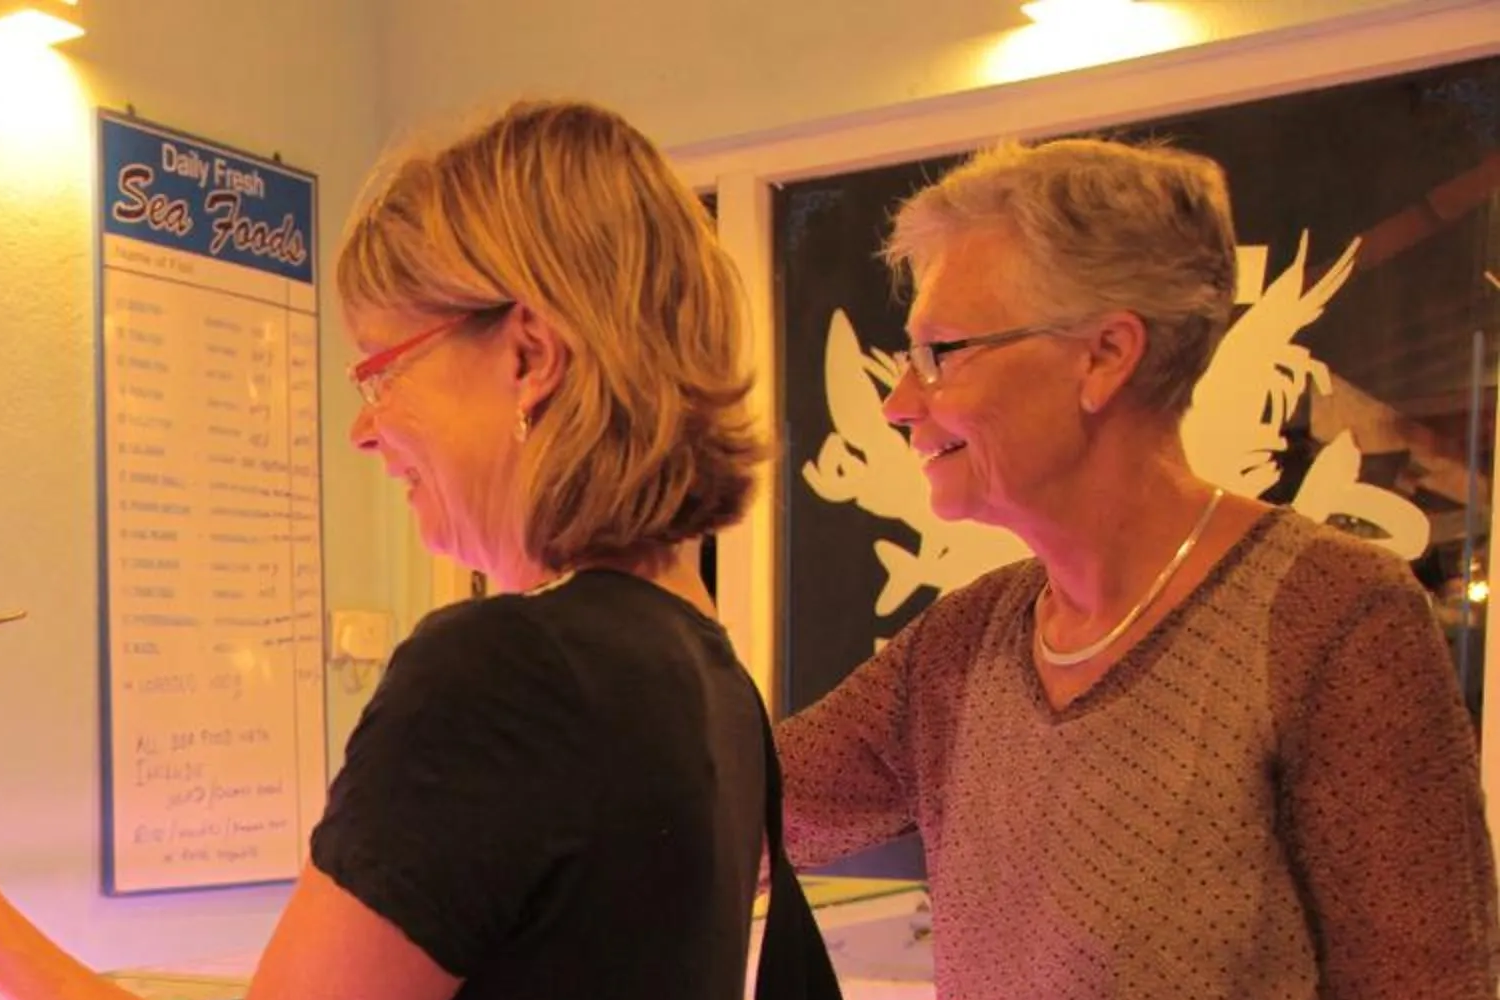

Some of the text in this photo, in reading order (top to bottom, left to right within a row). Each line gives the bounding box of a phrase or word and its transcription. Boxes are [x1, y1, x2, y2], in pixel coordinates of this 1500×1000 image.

[161, 143, 265, 198] Daily Fresh
[112, 163, 307, 265] Sea Foods
